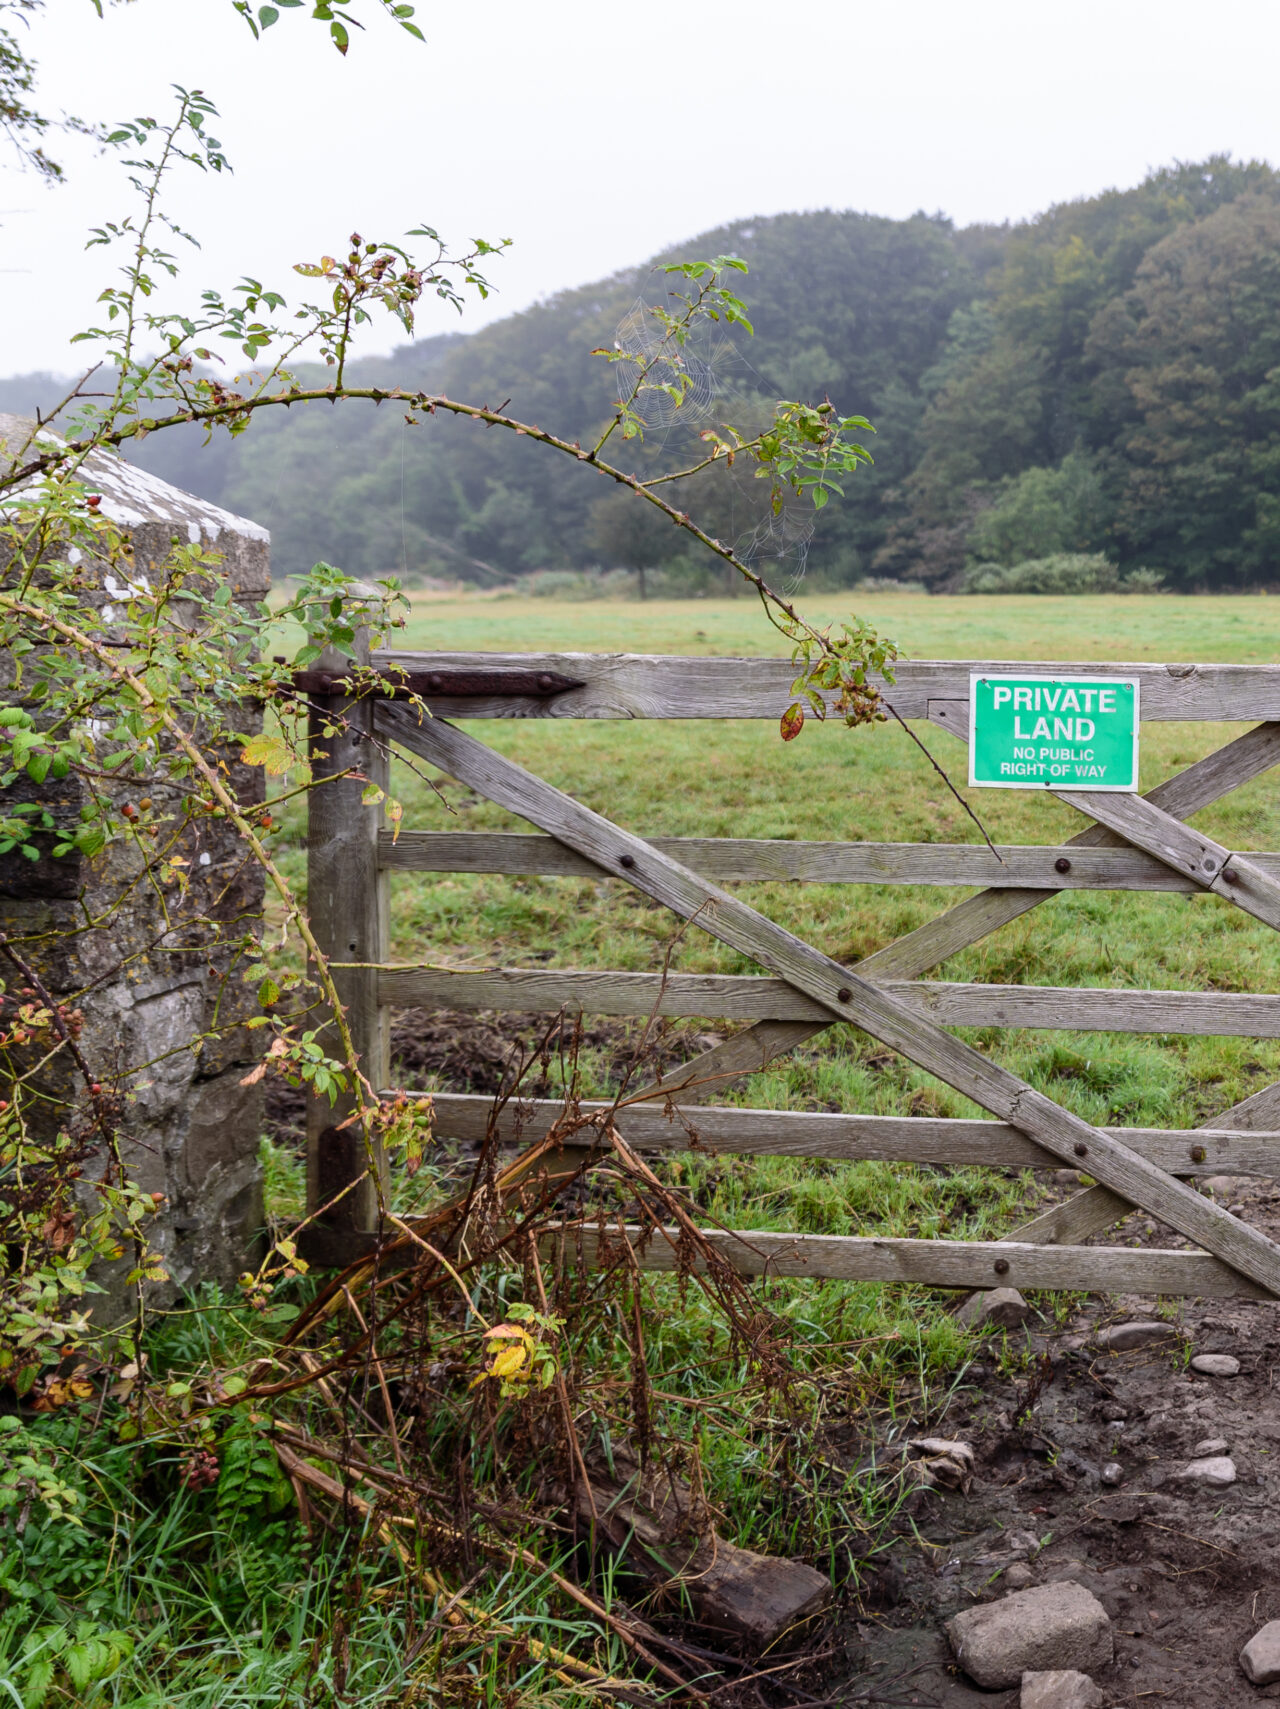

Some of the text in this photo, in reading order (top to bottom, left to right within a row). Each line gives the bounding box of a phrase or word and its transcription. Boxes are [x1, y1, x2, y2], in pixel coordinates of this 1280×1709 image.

[993, 686, 1117, 713] PRIVATE
[1014, 716, 1096, 741] LAND
[1013, 747, 1095, 761] NO PUBLIC
[1000, 762, 1107, 777] RIGHT OF WAY
